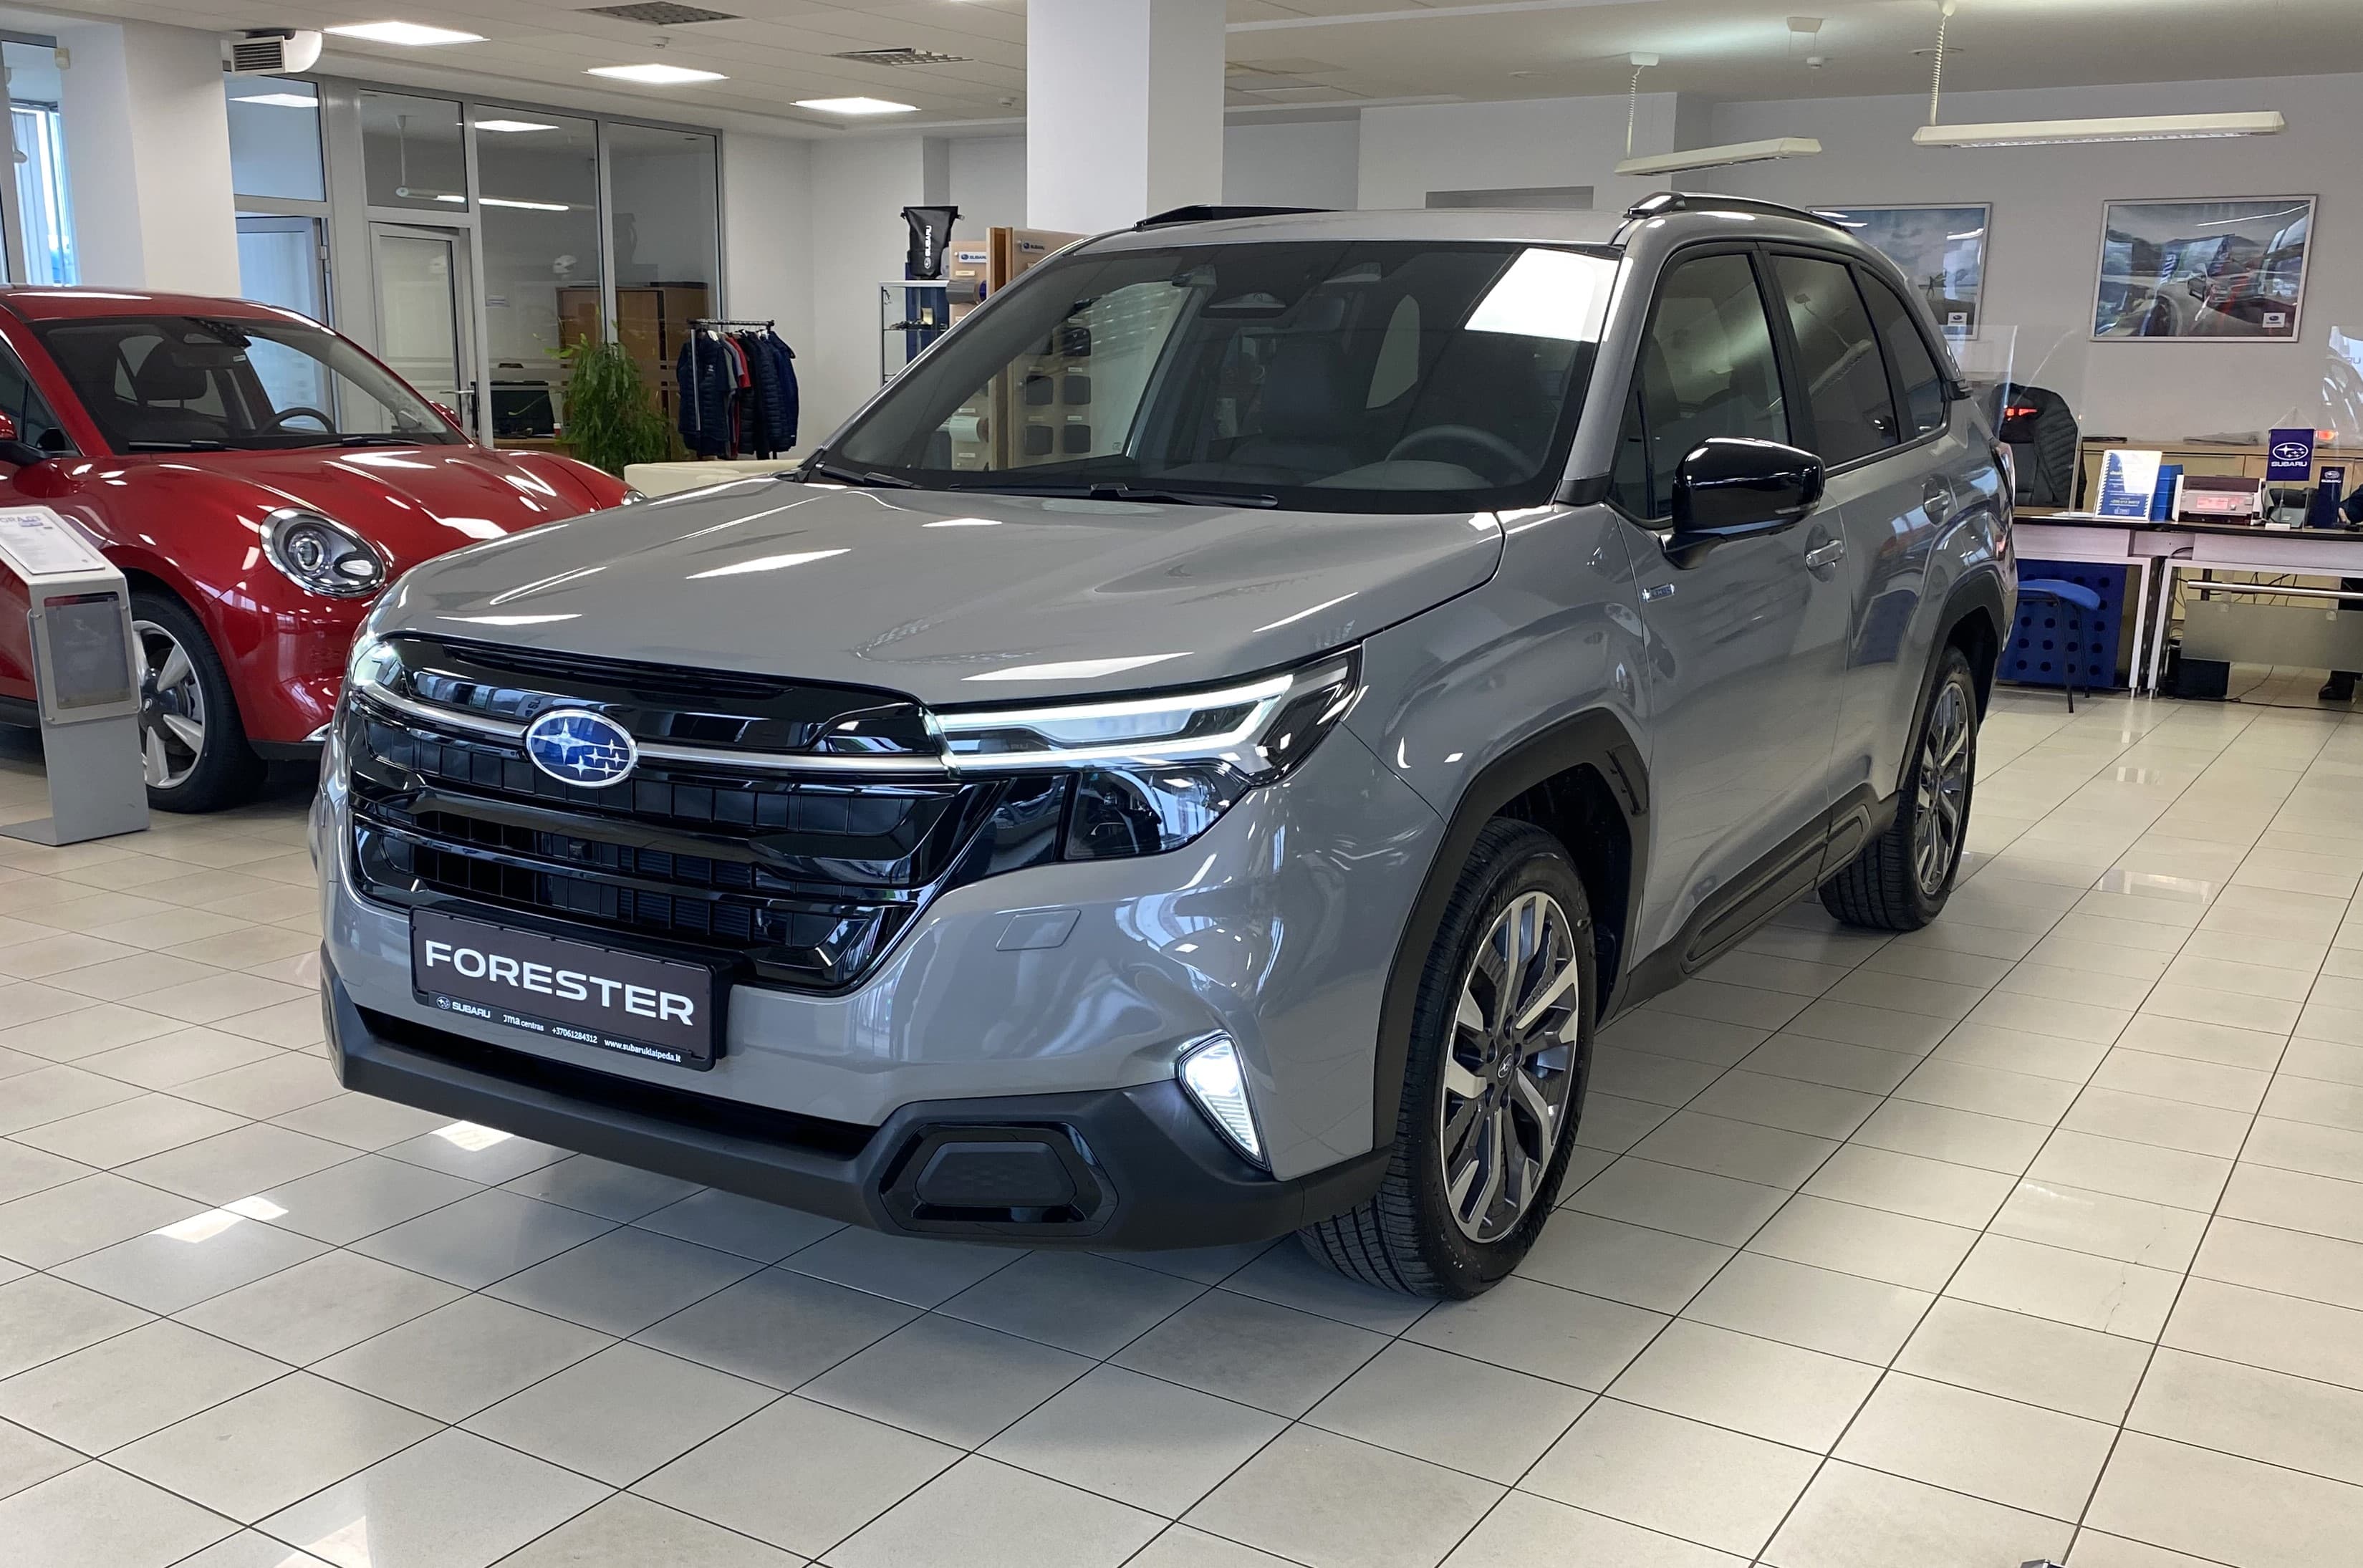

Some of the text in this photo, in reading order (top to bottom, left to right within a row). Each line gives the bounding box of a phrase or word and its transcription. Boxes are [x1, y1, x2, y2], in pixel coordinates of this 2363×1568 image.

[425, 939, 694, 1026] FORESTER
[452, 1001, 491, 1019] SUBARU
[521, 1020, 544, 1031] centras
[552, 1026, 597, 1044] +37061284312
[604, 1039, 681, 1063] www.subaruklaipeda.lt
